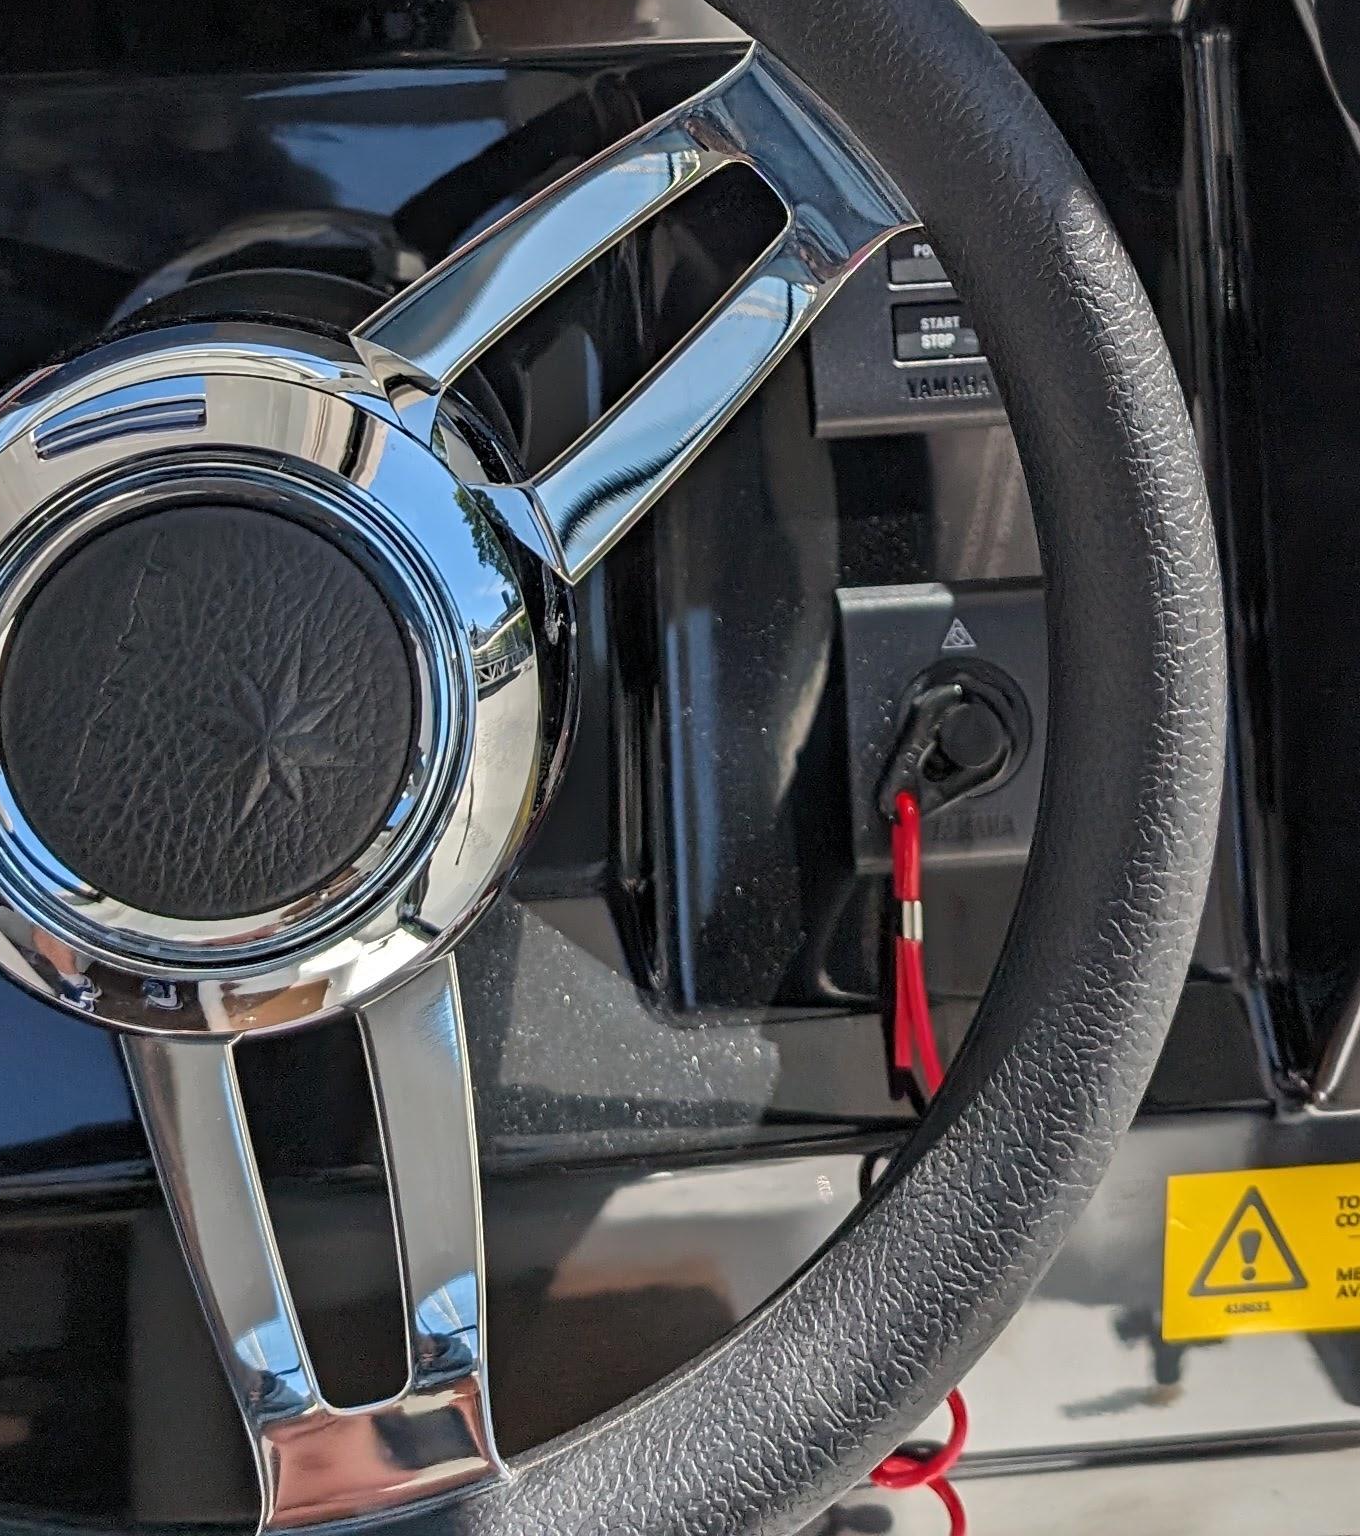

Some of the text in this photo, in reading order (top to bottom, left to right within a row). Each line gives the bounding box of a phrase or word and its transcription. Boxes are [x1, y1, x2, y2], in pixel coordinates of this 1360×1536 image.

[919, 315, 961, 331] START
[920, 333, 956, 350] STOP
[1336, 1195, 1360, 1210] TO
